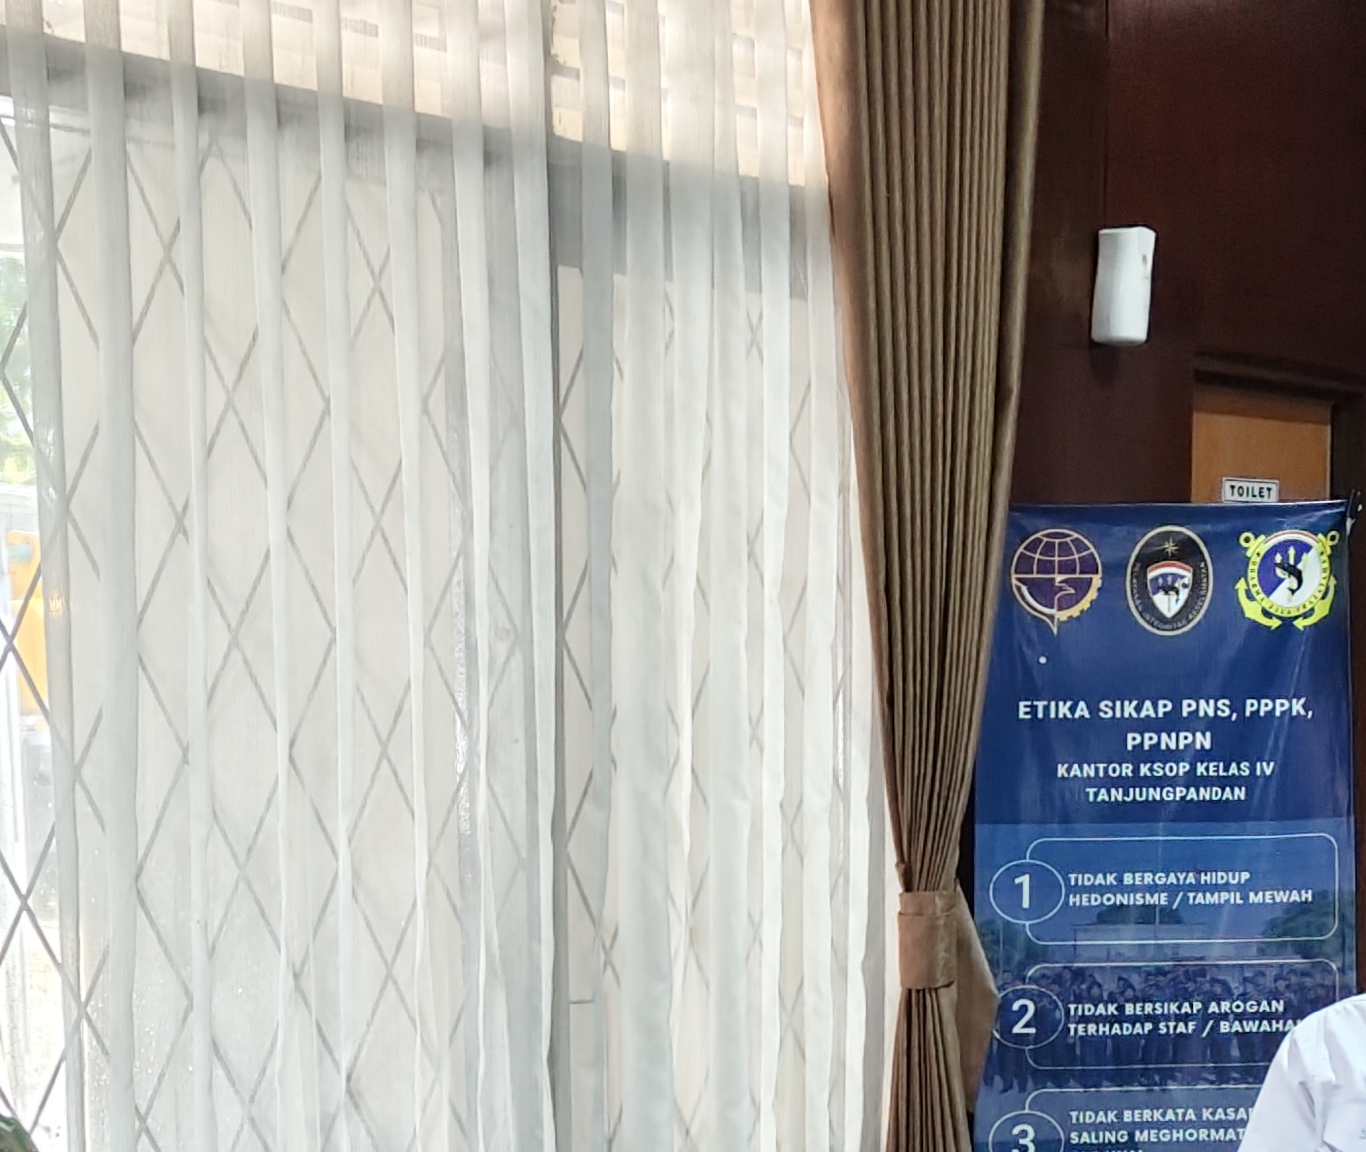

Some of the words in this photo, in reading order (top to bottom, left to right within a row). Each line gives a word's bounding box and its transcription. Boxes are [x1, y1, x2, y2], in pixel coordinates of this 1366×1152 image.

[1229, 483, 1273, 499] TOILET
[1018, 700, 1090, 719] ETIKA
[1098, 700, 1173, 719] SIKAP
[1181, 699, 1237, 722] PNS,
[1245, 697, 1313, 720] PPPK,
[1126, 731, 1212, 751] PPNPN
[1057, 762, 1133, 778] KANTOR
[1139, 762, 1189, 778] KSOP
[1196, 761, 1250, 777] KELAS
[1256, 761, 1275, 776] IV
[1086, 786, 1247, 802] TANJUNGPANDAN
[1068, 872, 1118, 887] TIDAK
[1123, 871, 1197, 886] BERGAYA
[1200, 870, 1250, 885] HIDUP
[1013, 873, 1031, 909] 1
[1068, 891, 1169, 907] HEDONISME
[1172, 890, 1184, 909] /
[1187, 891, 1244, 905] TAMPIL
[1248, 888, 1313, 904] MEWAH
[1068, 1002, 1118, 1016] TIDAK
[1125, 1001, 1203, 1015] BERSIKAP
[1208, 1000, 1284, 1014] AROGAN
[1011, 999, 1036, 1035] 2
[1068, 1022, 1153, 1036] TERHADAP
[1158, 1021, 1197, 1034] STAF
[1201, 1019, 1214, 1037] /
[1069, 1110, 1118, 1124] TIDAK
[1123, 1108, 1196, 1122] BERKATA
[1069, 1130, 1129, 1144] SALING
[1135, 1128, 1248, 1142] MEGHORMAT
